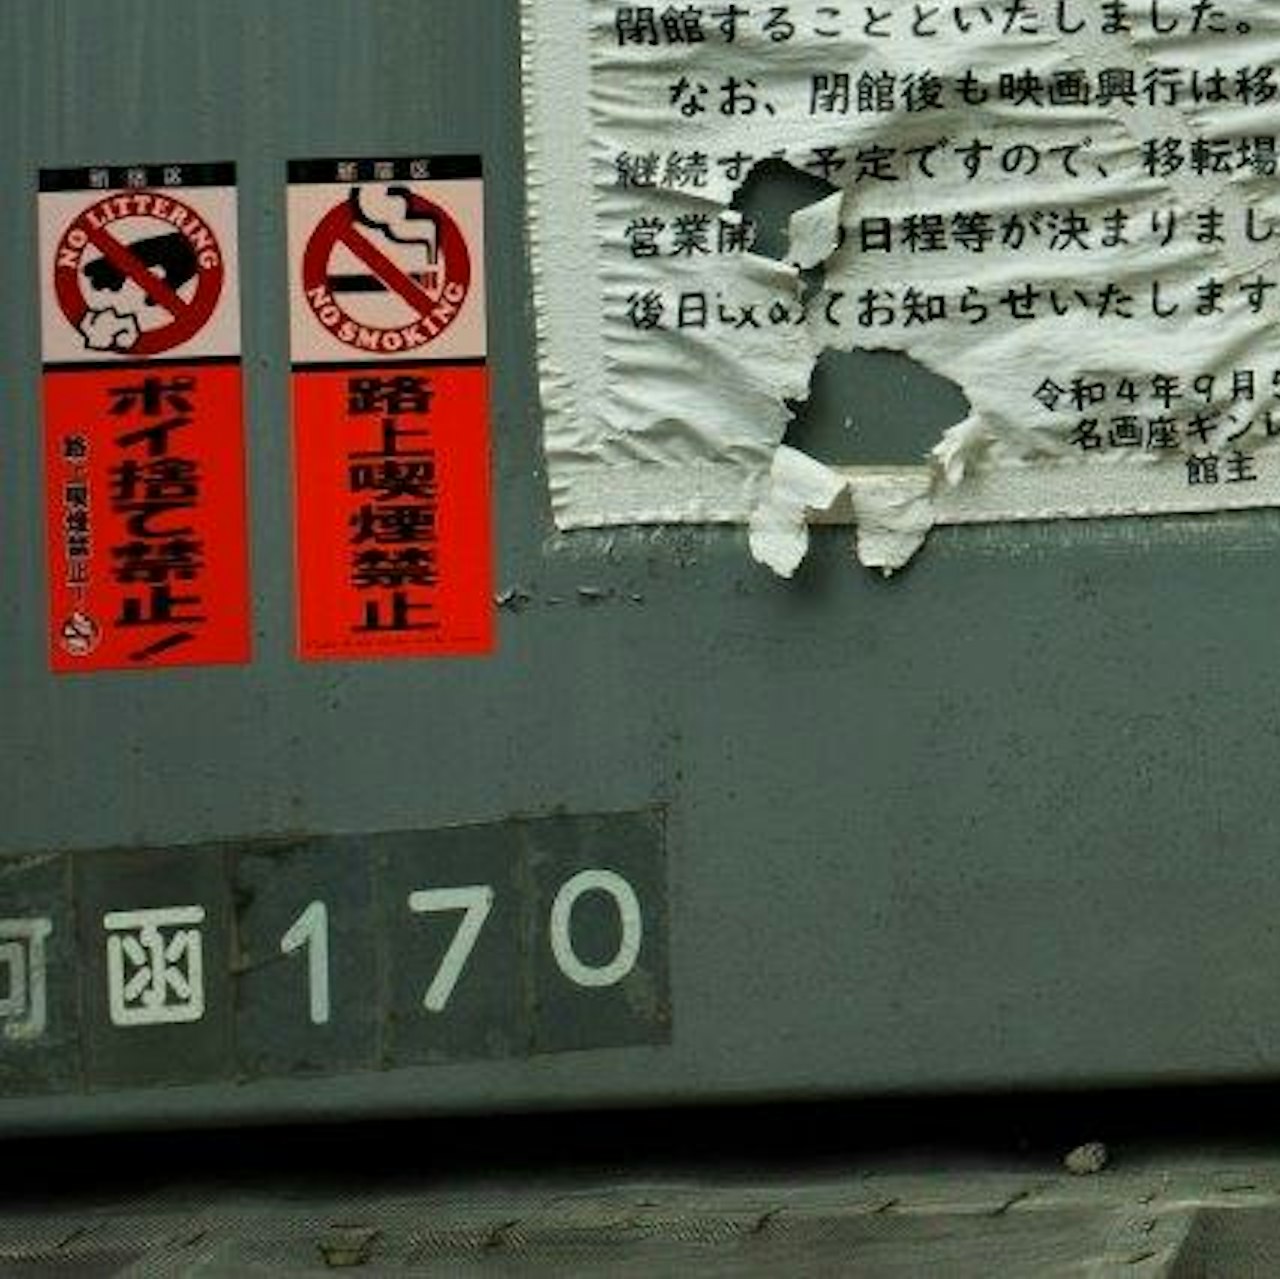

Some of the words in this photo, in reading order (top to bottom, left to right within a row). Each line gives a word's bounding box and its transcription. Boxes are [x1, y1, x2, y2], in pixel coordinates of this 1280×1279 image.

[615, 0, 1255, 47] 閉館することといたしました。
[59, 228, 89, 269] NO
[86, 192, 219, 270] LITTERING
[306, 283, 341, 329] NO
[337, 279, 466, 352] SMOKING
[347, 375, 438, 633] 路上喫煙禁止
[1186, 451, 1258, 485] 館主
